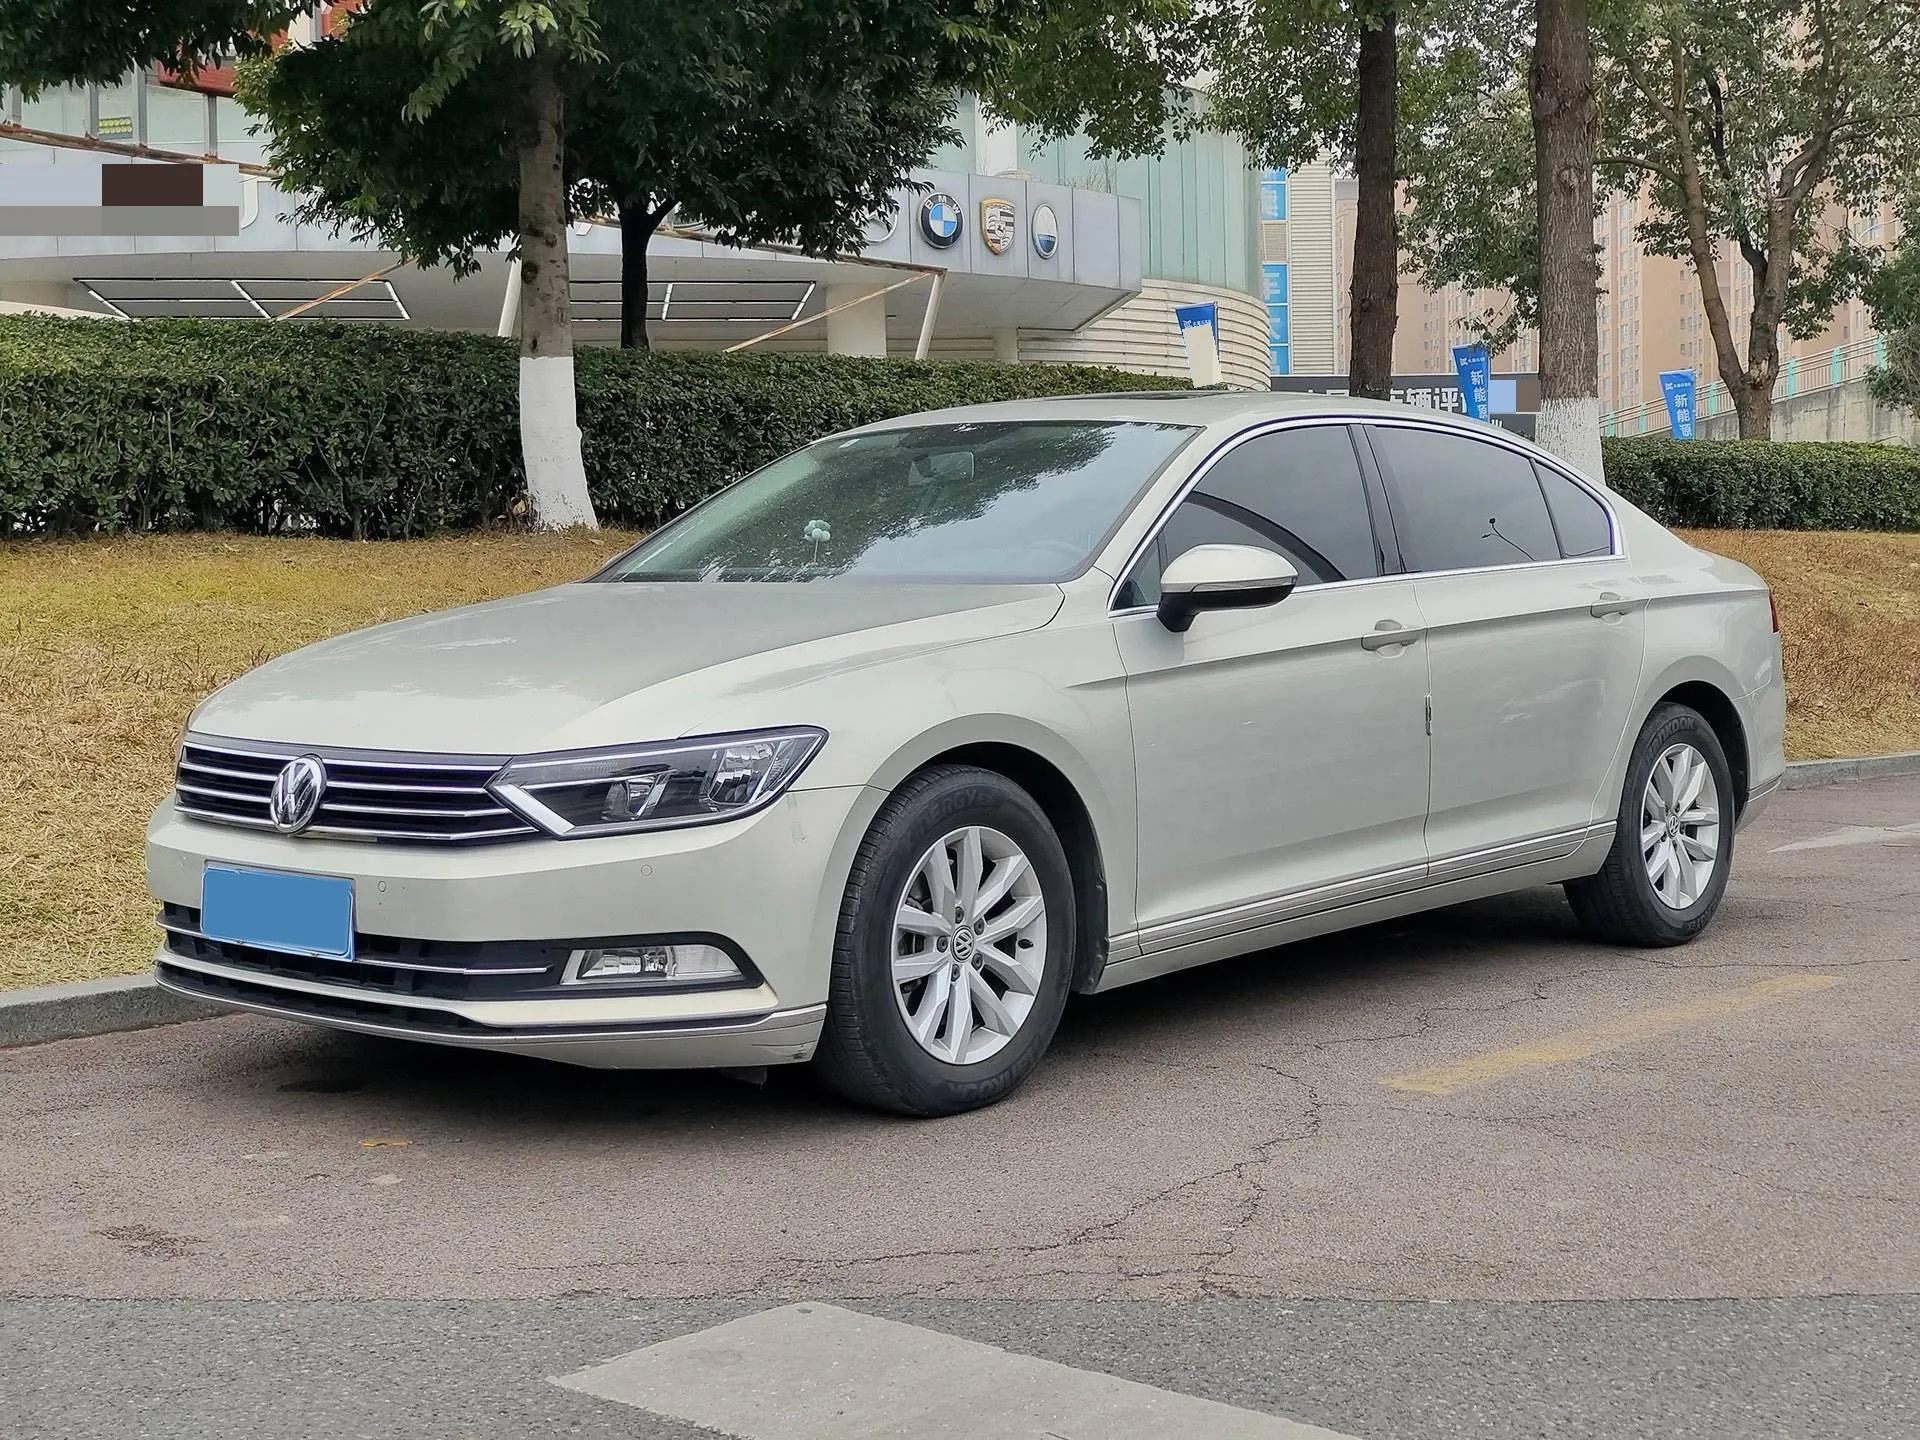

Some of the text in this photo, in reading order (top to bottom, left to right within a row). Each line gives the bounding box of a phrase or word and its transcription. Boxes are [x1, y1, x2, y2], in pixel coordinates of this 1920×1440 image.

[924, 195, 961, 215] BMW
[1470, 370, 1488, 419] 新能源
[1674, 393, 1693, 437] 新能源
